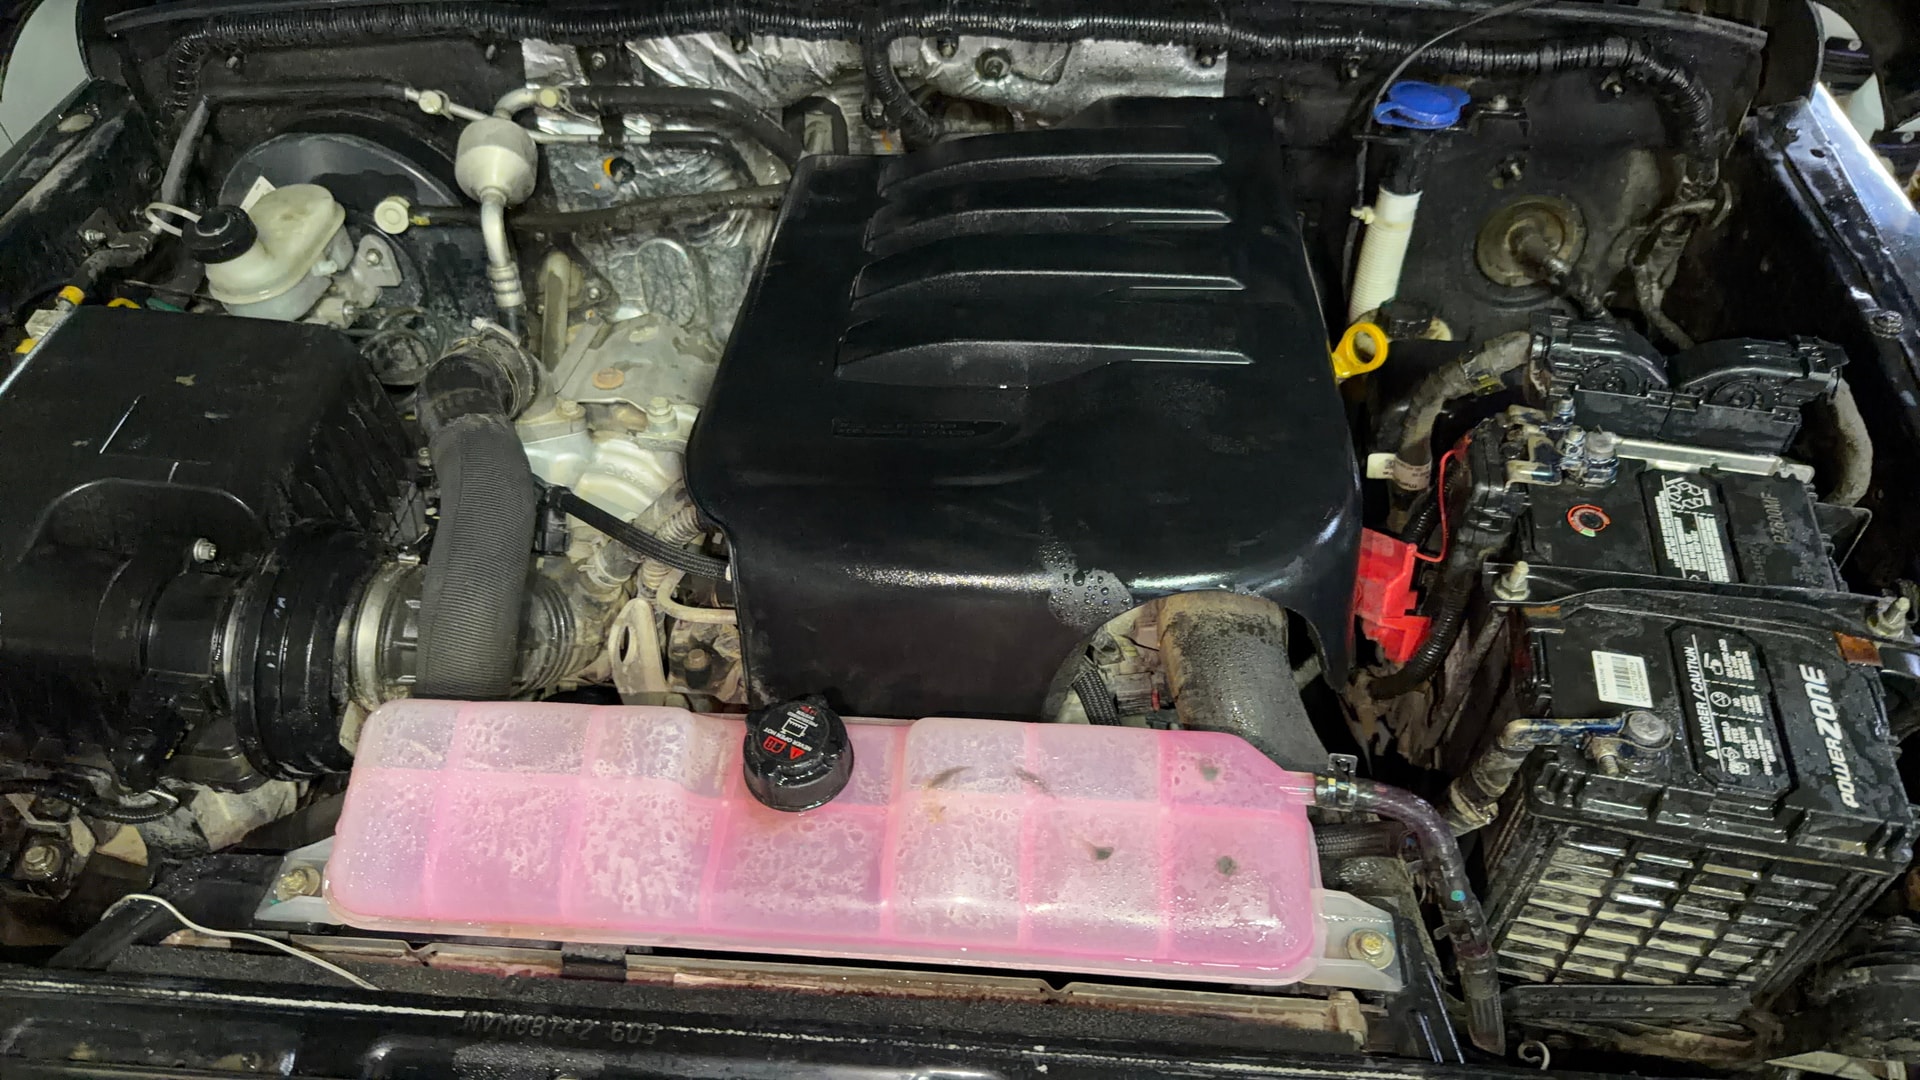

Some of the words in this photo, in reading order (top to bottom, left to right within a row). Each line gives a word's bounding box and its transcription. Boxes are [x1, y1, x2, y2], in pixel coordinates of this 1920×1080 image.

[763, 727, 777, 736] HOT
[1800, 664, 1861, 808] POWERZONE
[776, 732, 793, 743] OPEN
[792, 740, 813, 752] NEVER
